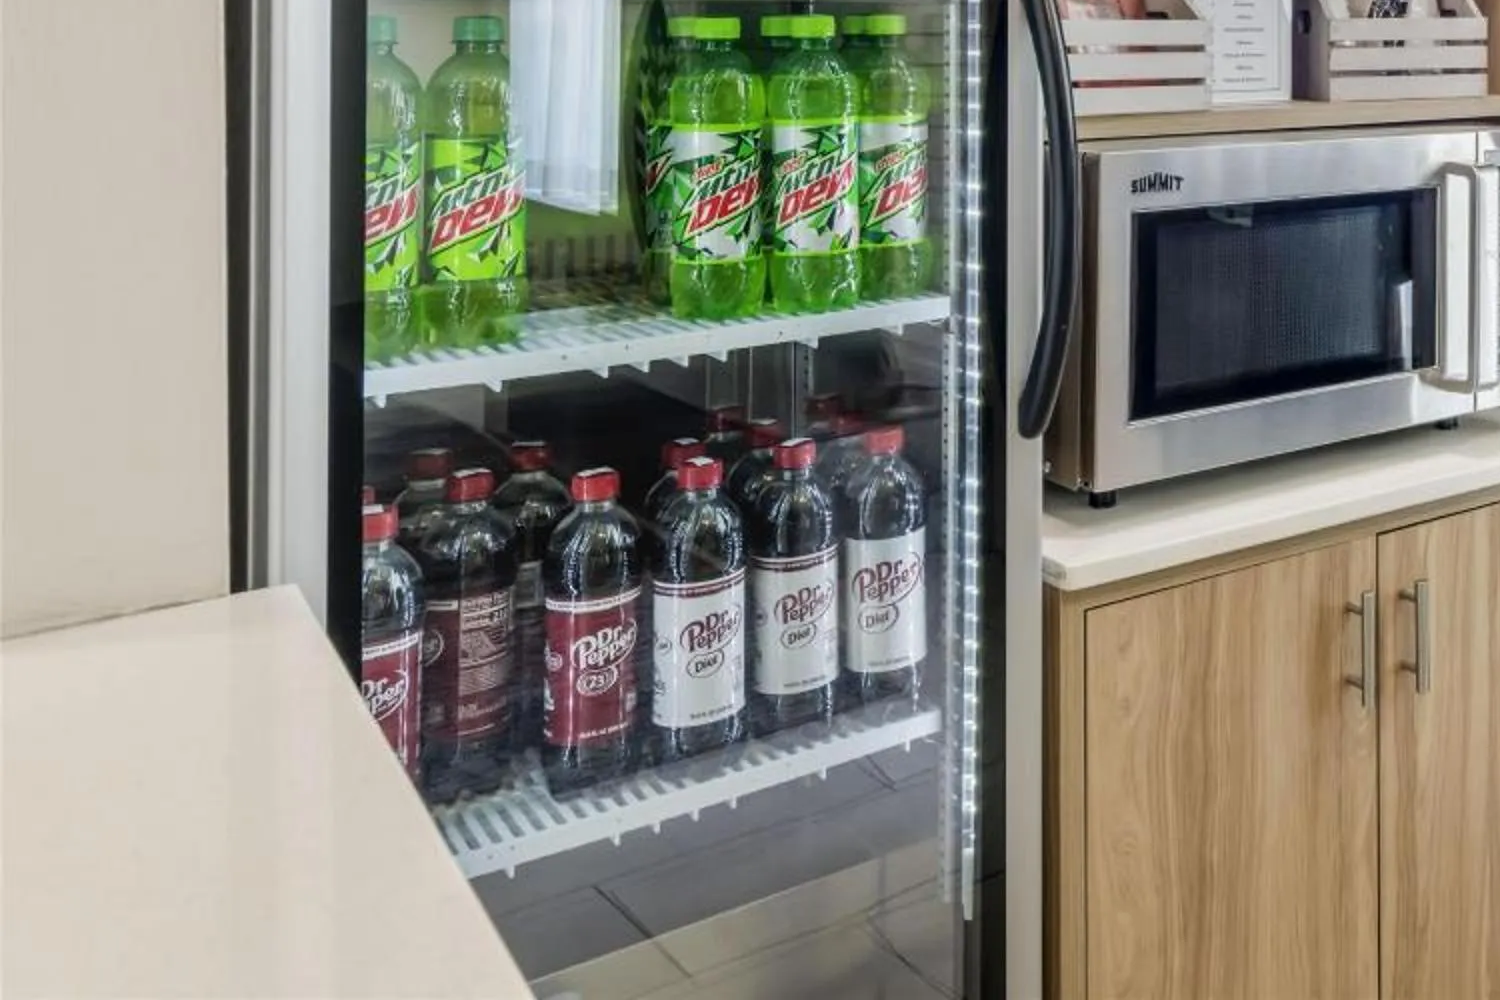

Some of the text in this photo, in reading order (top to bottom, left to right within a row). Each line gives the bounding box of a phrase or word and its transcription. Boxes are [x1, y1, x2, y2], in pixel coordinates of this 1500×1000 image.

[1130, 171, 1185, 194] SUMMIT
[876, 560, 903, 579] Dr
[798, 585, 821, 602] Dr
[855, 562, 920, 604] Pepper
[776, 590, 832, 625] Pepper
[706, 609, 729, 629] Dr
[597, 626, 623, 648] Dr
[681, 612, 741, 652] Pepper
[573, 628, 636, 670] Pepper
[695, 654, 718, 673] Diet
